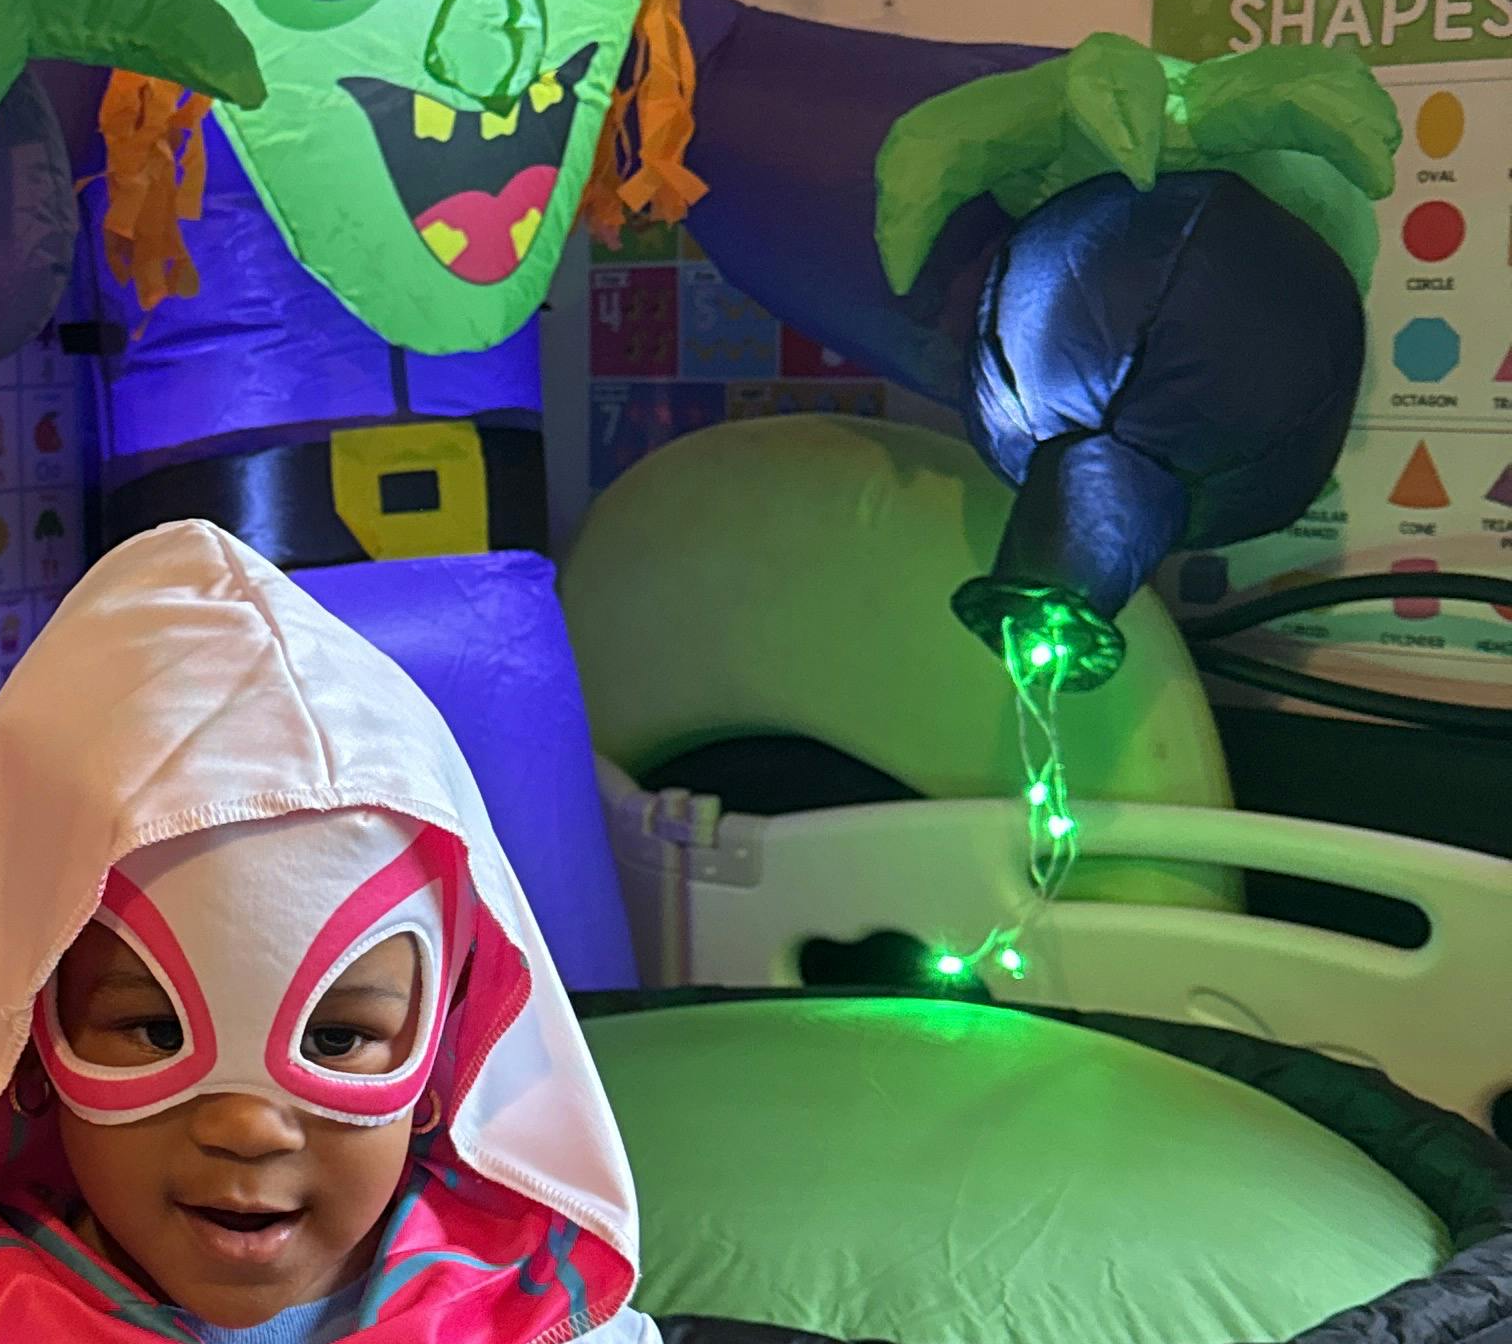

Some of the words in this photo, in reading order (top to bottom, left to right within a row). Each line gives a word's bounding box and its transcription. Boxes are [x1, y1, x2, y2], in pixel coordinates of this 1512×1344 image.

[1416, 170, 1456, 183] OVAL
[1406, 277, 1455, 291] CIRCLE
[1391, 394, 1459, 408] OCTAGON
[1399, 520, 1437, 536] CONE
